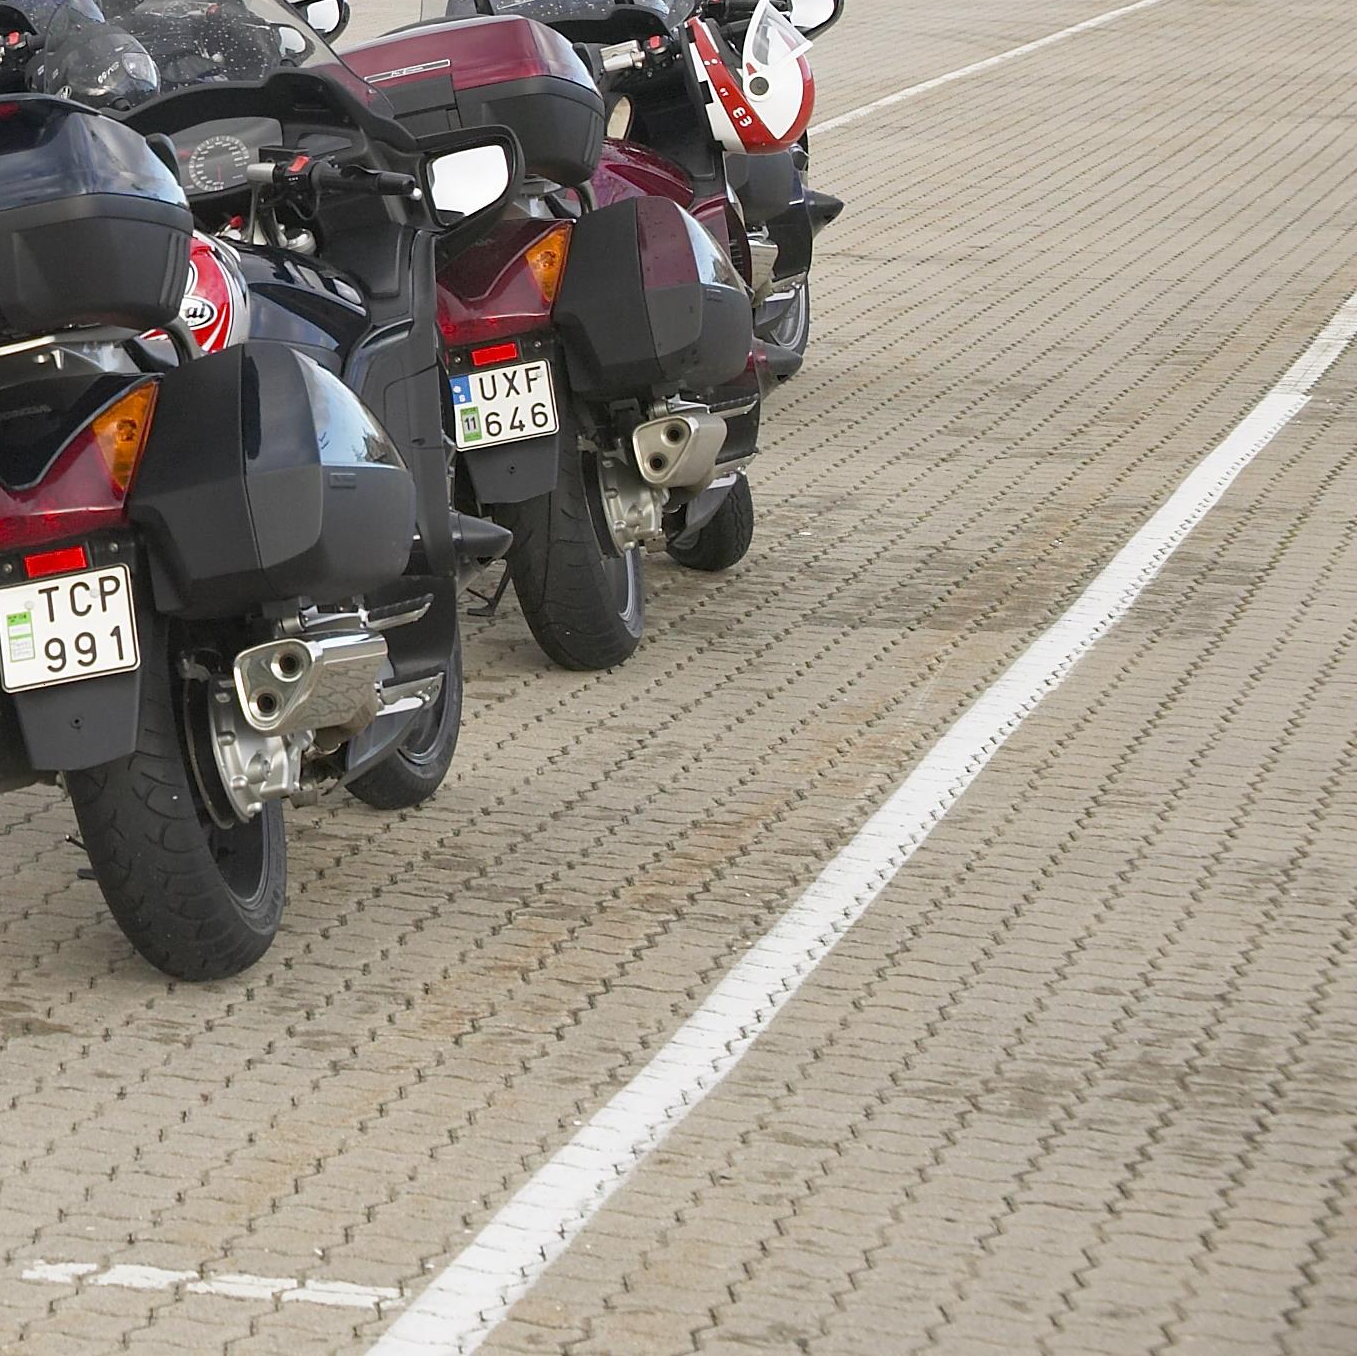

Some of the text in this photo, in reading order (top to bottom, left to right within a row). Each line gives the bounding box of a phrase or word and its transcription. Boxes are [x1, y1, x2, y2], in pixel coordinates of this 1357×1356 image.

[479, 366, 541, 401] UXF
[464, 416, 477, 431] 11
[485, 402, 548, 437] 646
[38, 575, 121, 623] TCP
[44, 625, 124, 672] 991
